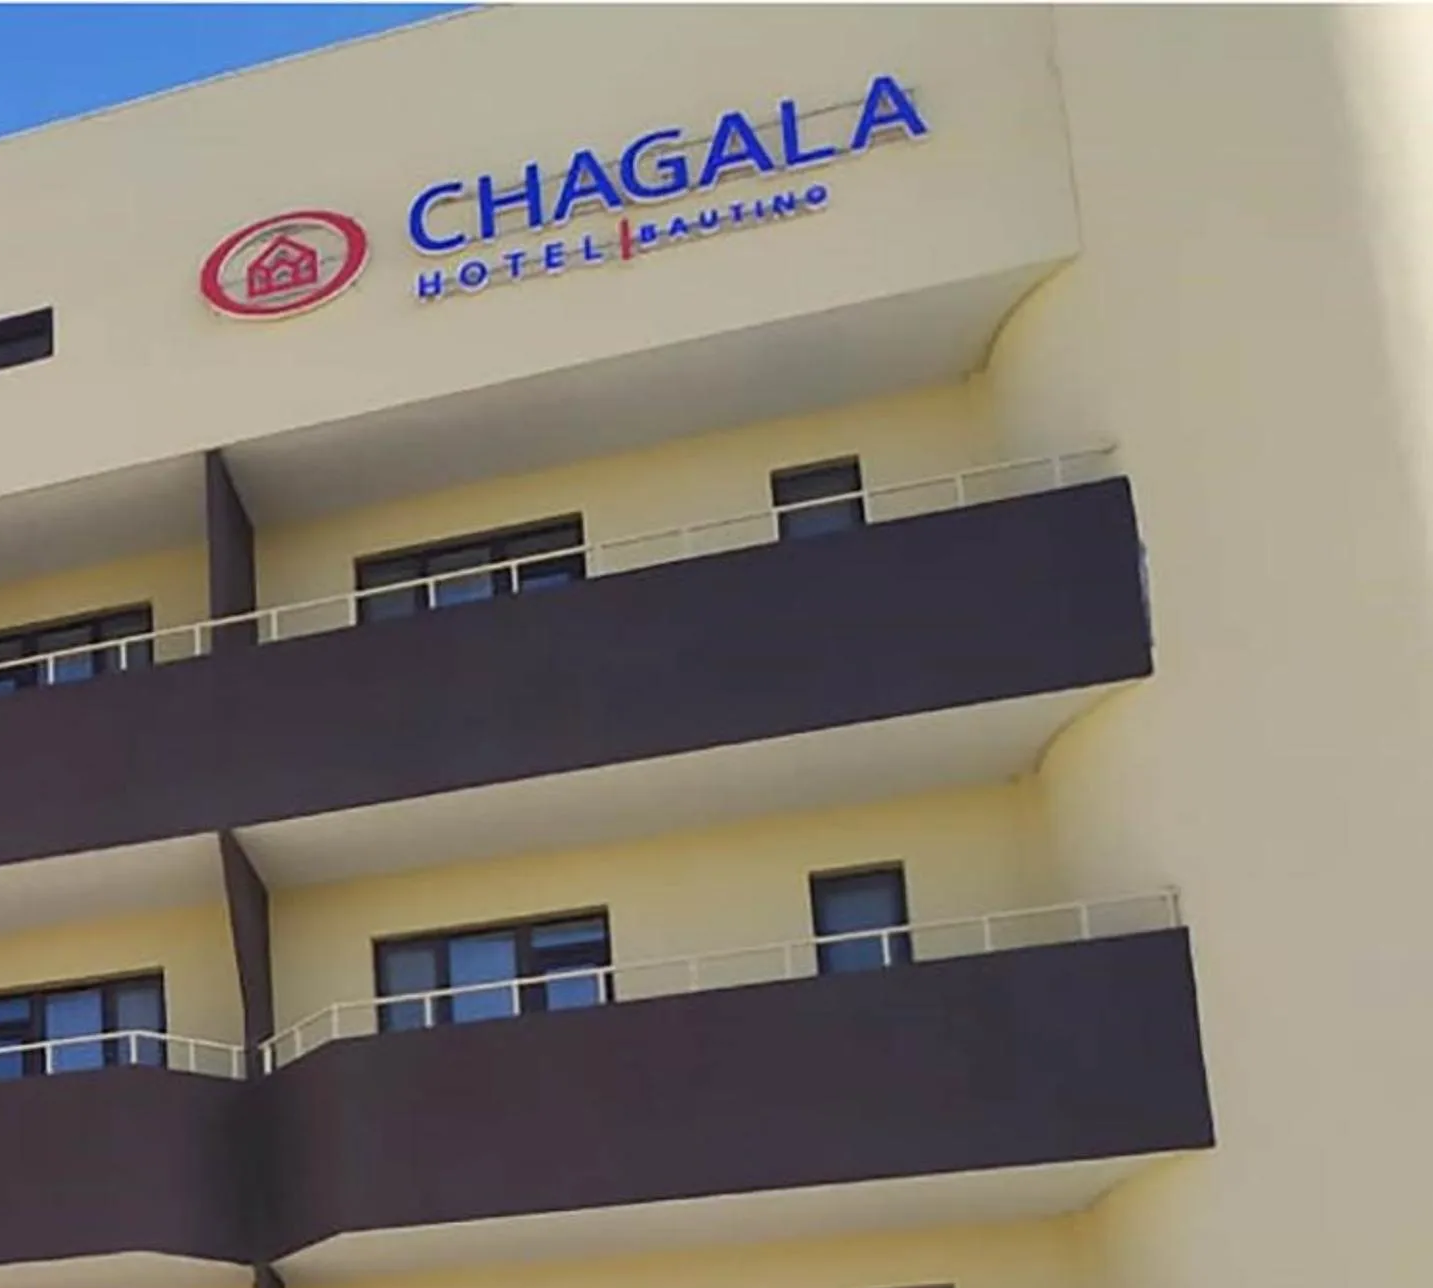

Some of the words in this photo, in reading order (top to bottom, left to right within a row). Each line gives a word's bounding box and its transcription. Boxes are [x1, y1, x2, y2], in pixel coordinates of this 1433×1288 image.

[406, 74, 928, 253] CHAGALA
[415, 235, 604, 299] HOTEL
[636, 183, 829, 245] BAUTINO
